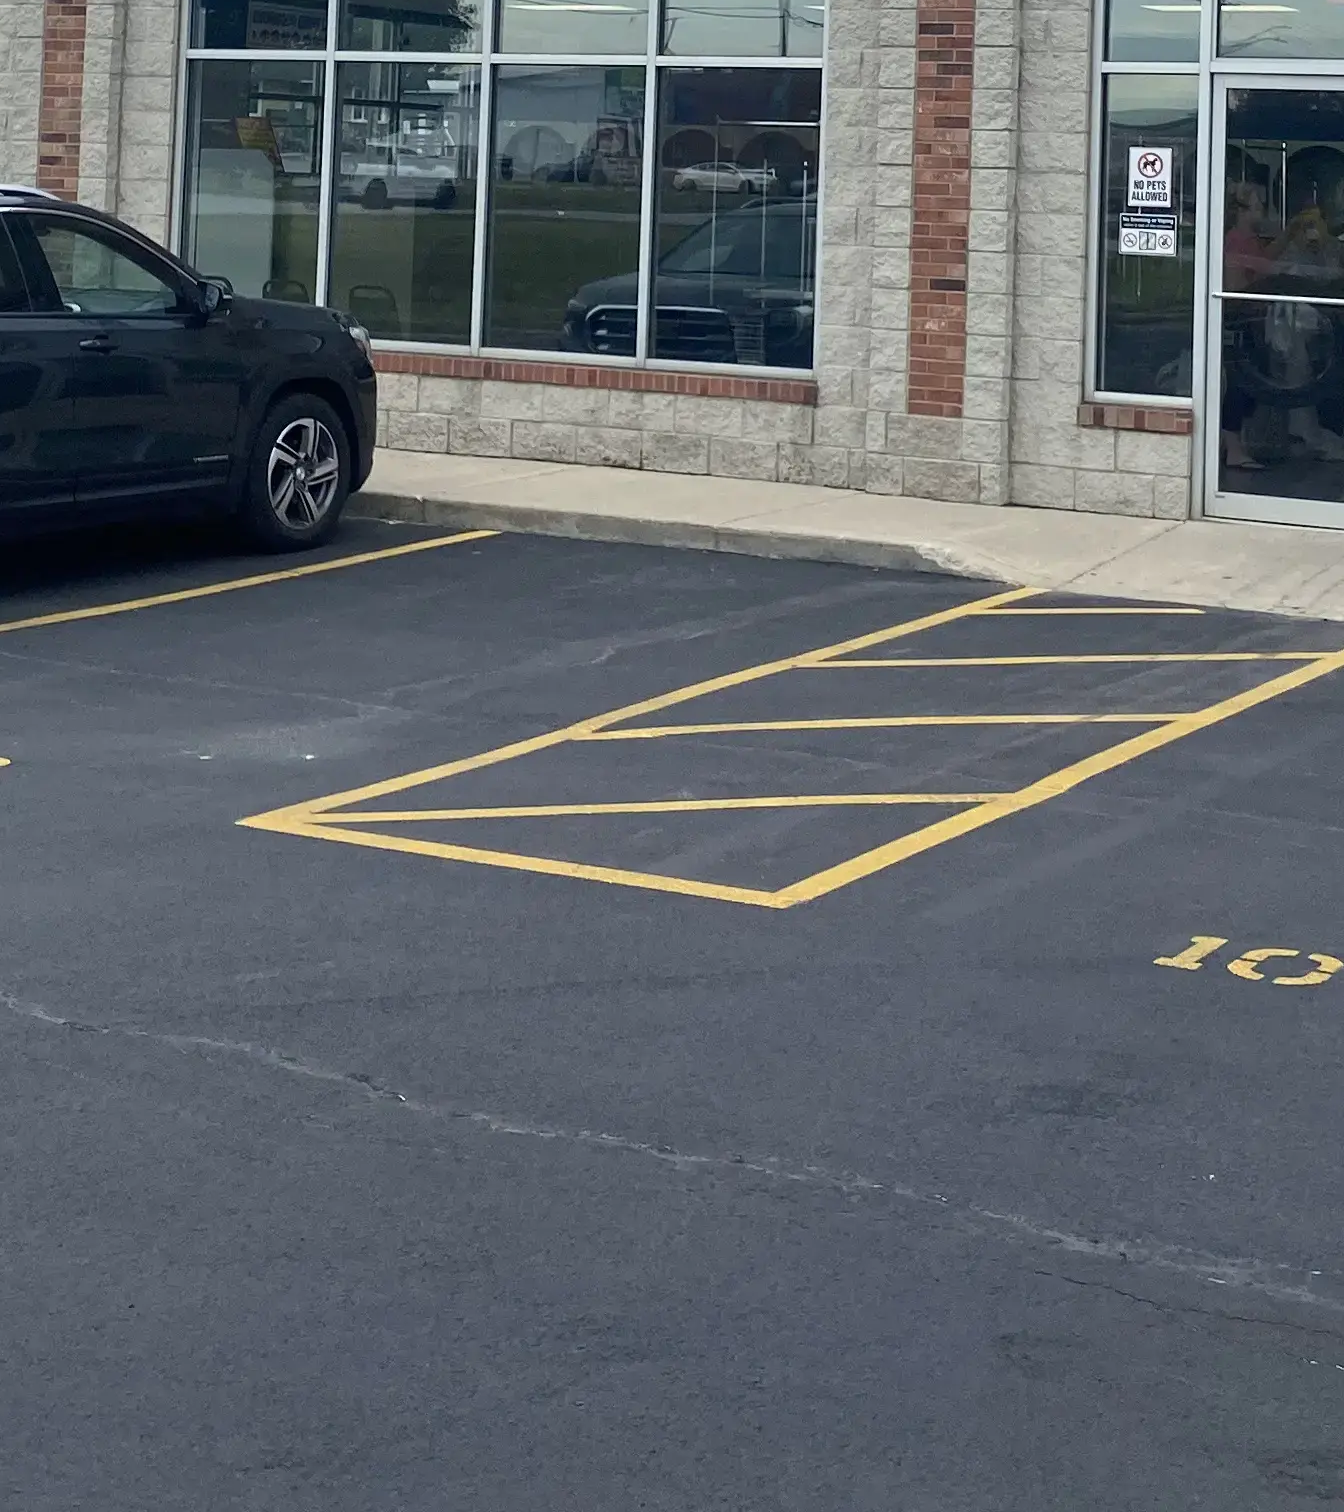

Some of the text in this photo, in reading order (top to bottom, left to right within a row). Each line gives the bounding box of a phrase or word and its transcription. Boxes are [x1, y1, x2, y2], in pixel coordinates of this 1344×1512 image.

[1133, 180, 1167, 191] NO PETS
[1131, 191, 1167, 201] ALLOWED
